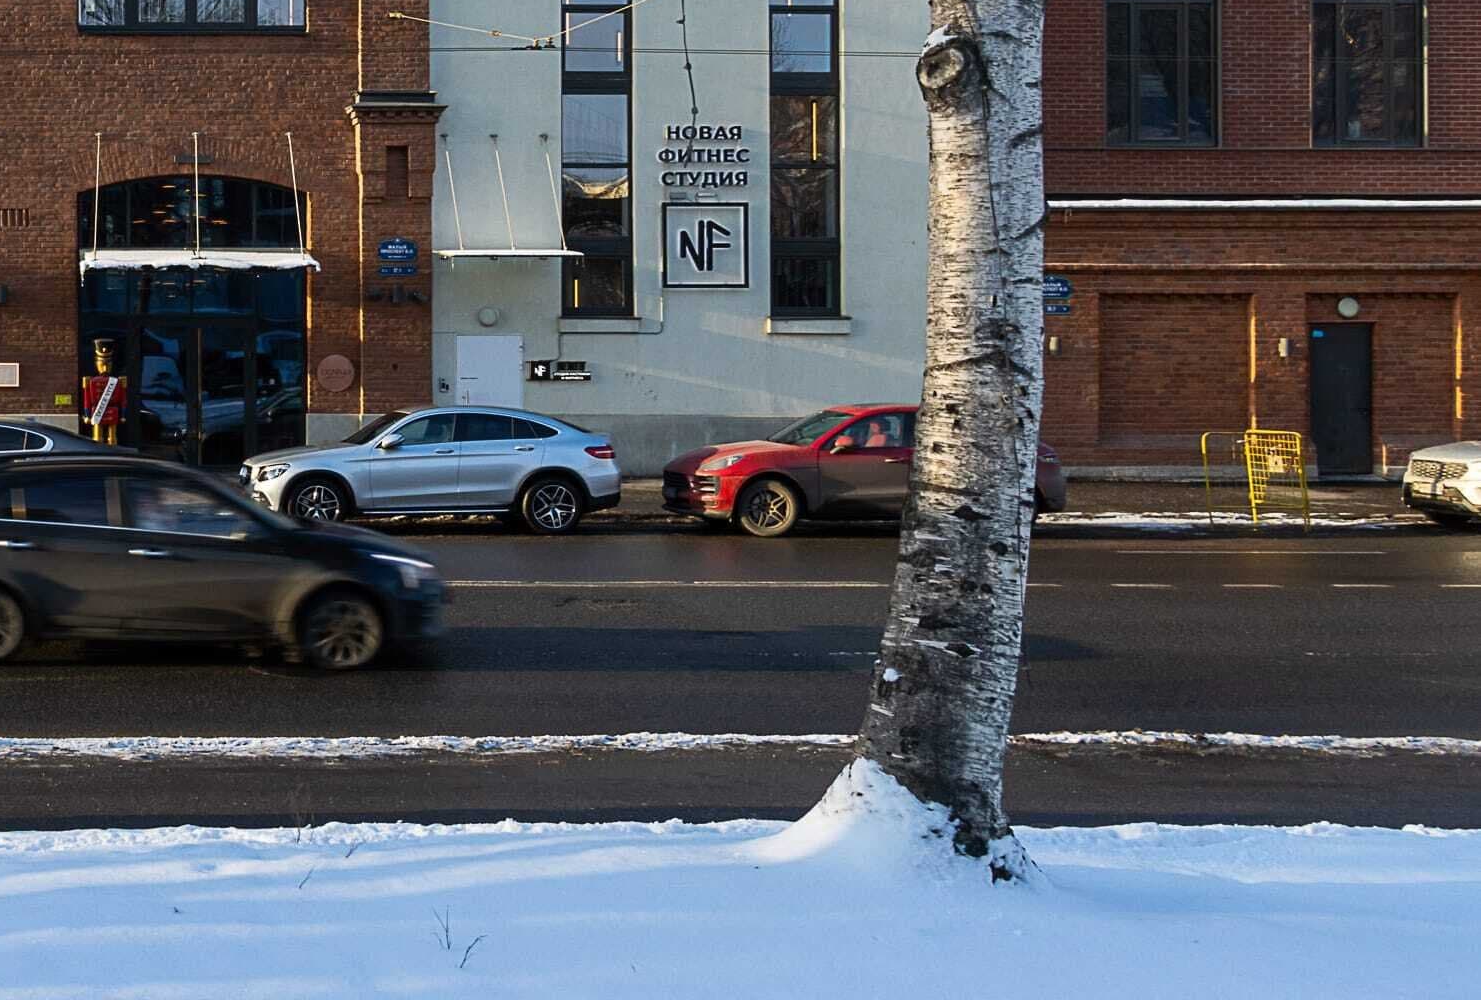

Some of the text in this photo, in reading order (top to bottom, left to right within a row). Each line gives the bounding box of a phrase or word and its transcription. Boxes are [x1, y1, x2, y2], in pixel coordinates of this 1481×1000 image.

[666, 125, 742, 141] НОВАЯ
[658, 148, 750, 163] ФИТНЕС
[661, 171, 748, 188] СТУДИЯ
[679, 219, 731, 271] NF
